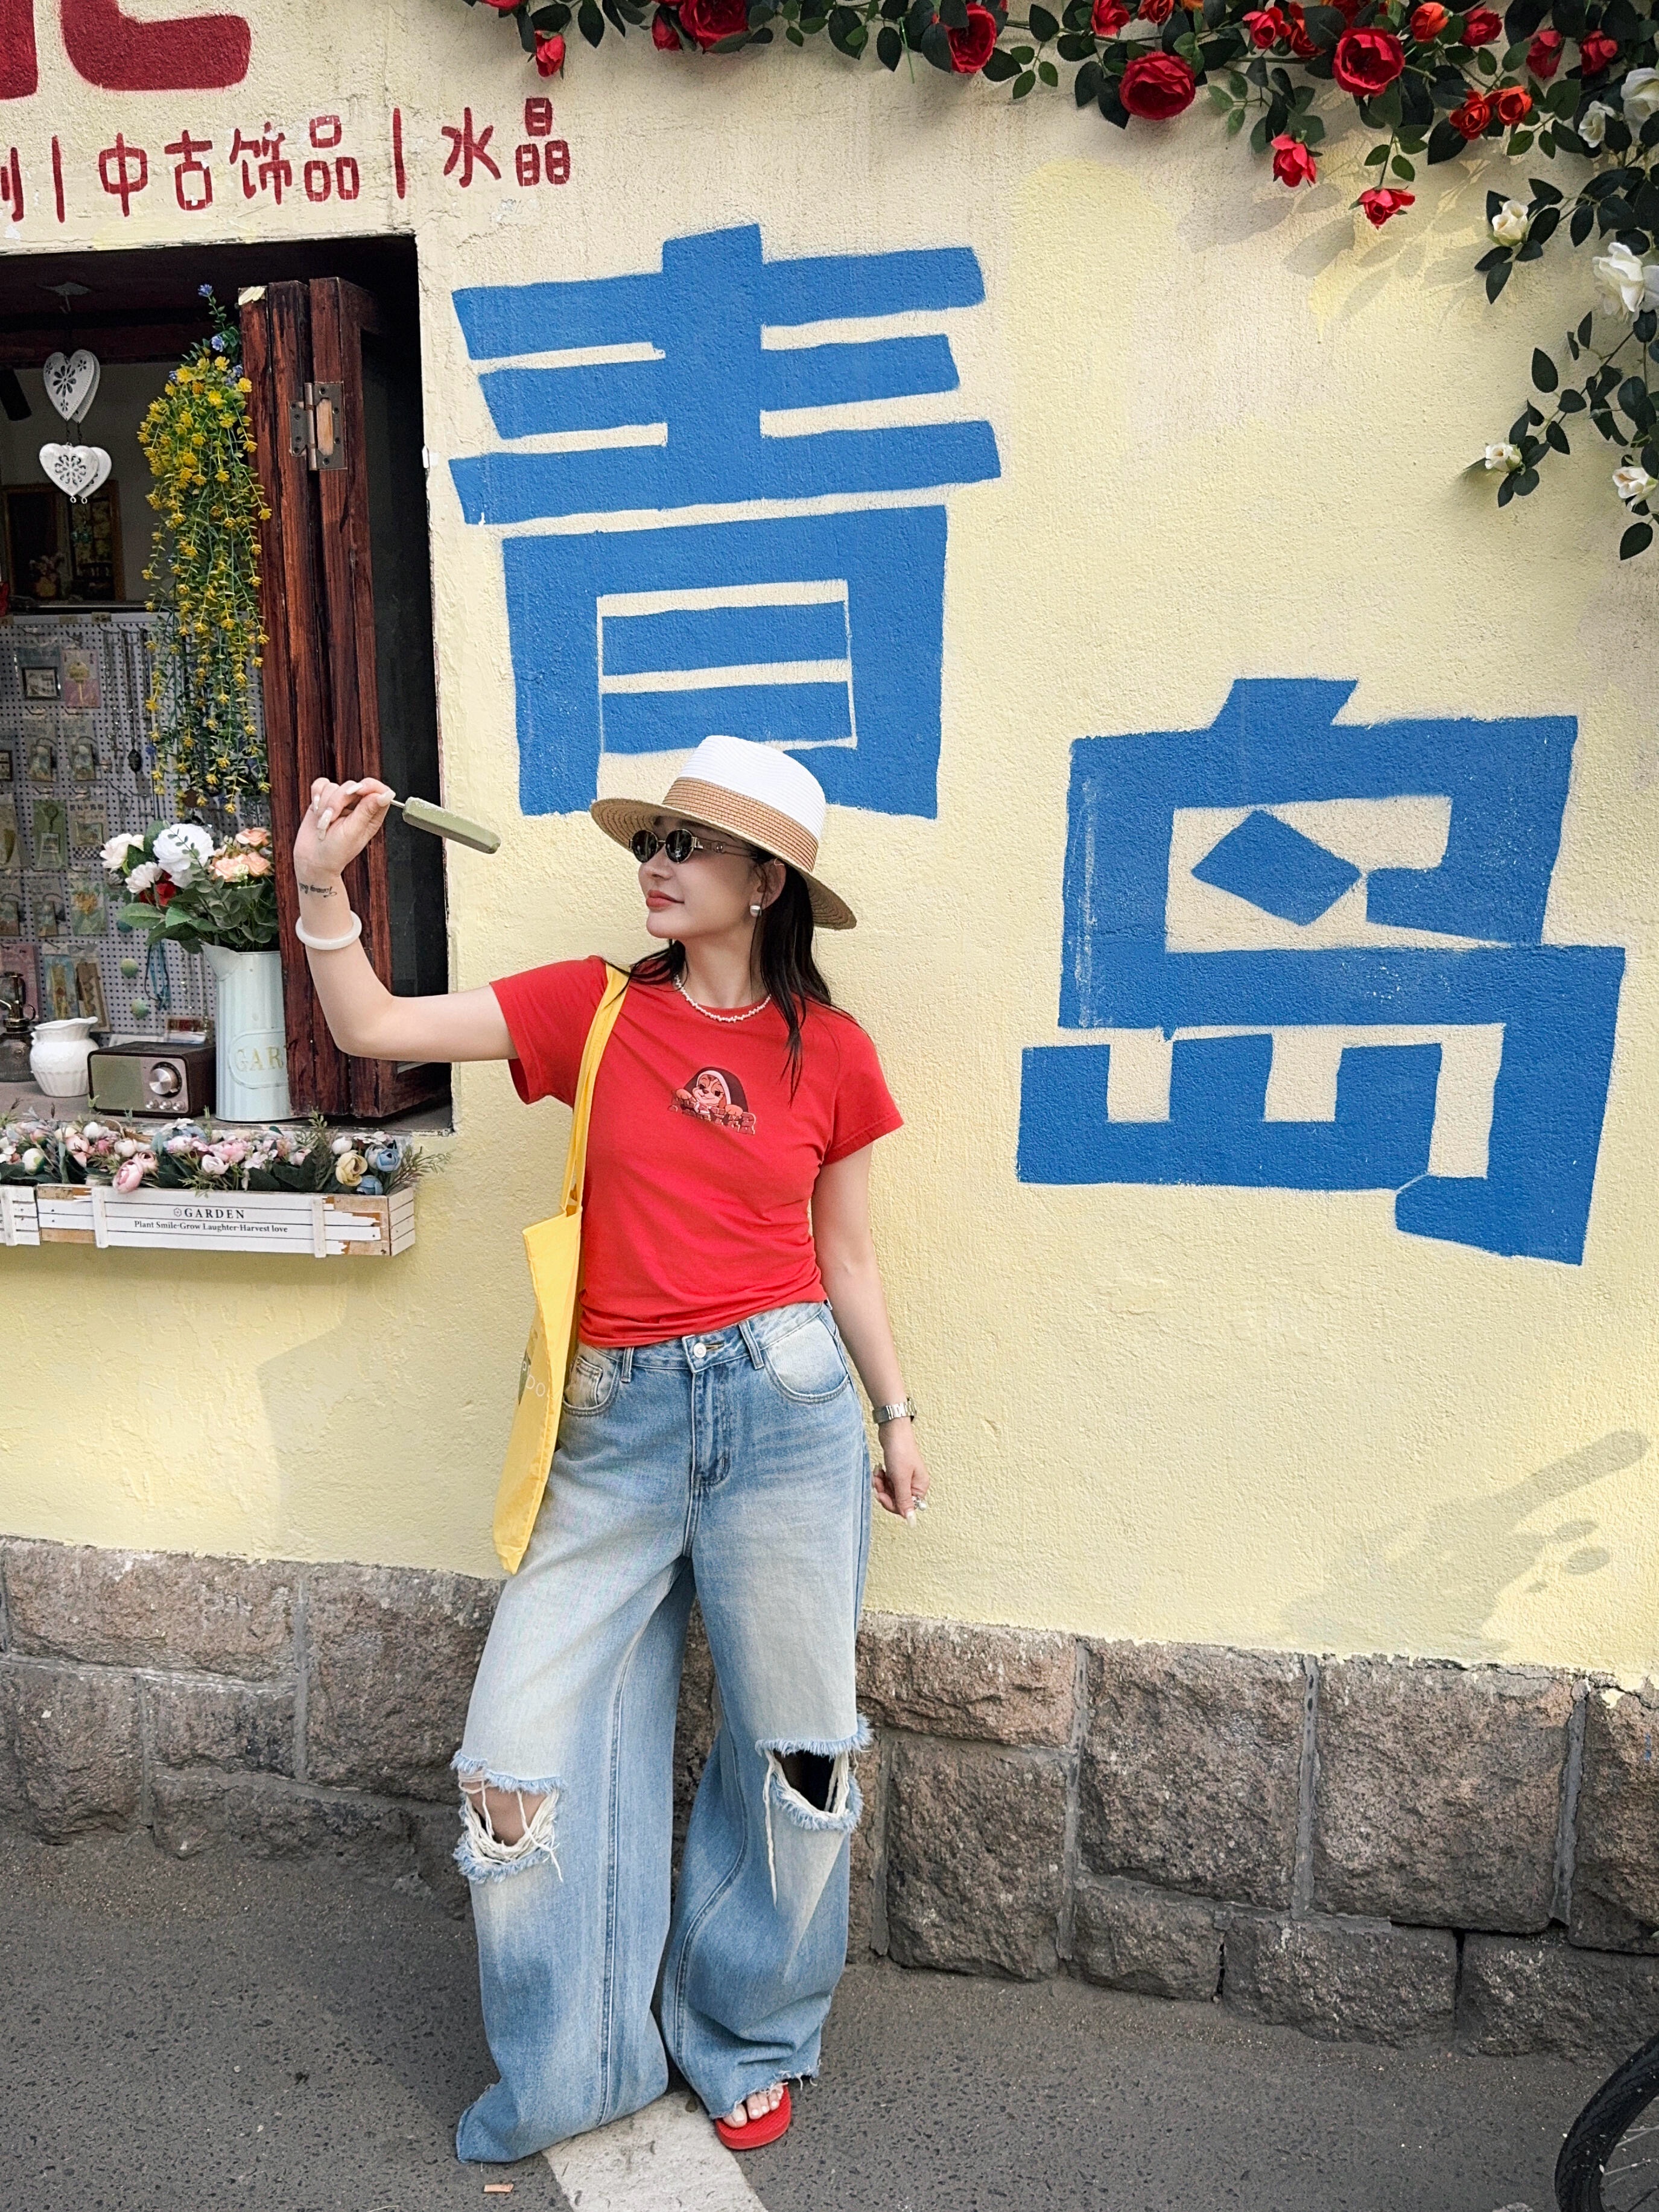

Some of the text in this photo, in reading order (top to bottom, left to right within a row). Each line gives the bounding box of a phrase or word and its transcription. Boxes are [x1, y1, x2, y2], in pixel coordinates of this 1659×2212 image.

[98, 114, 360, 218] 中古饰品
[442, 97, 571, 188] 水晶
[185, 1207, 245, 1219] GARDEN
[134, 1220, 154, 1229] Plant
